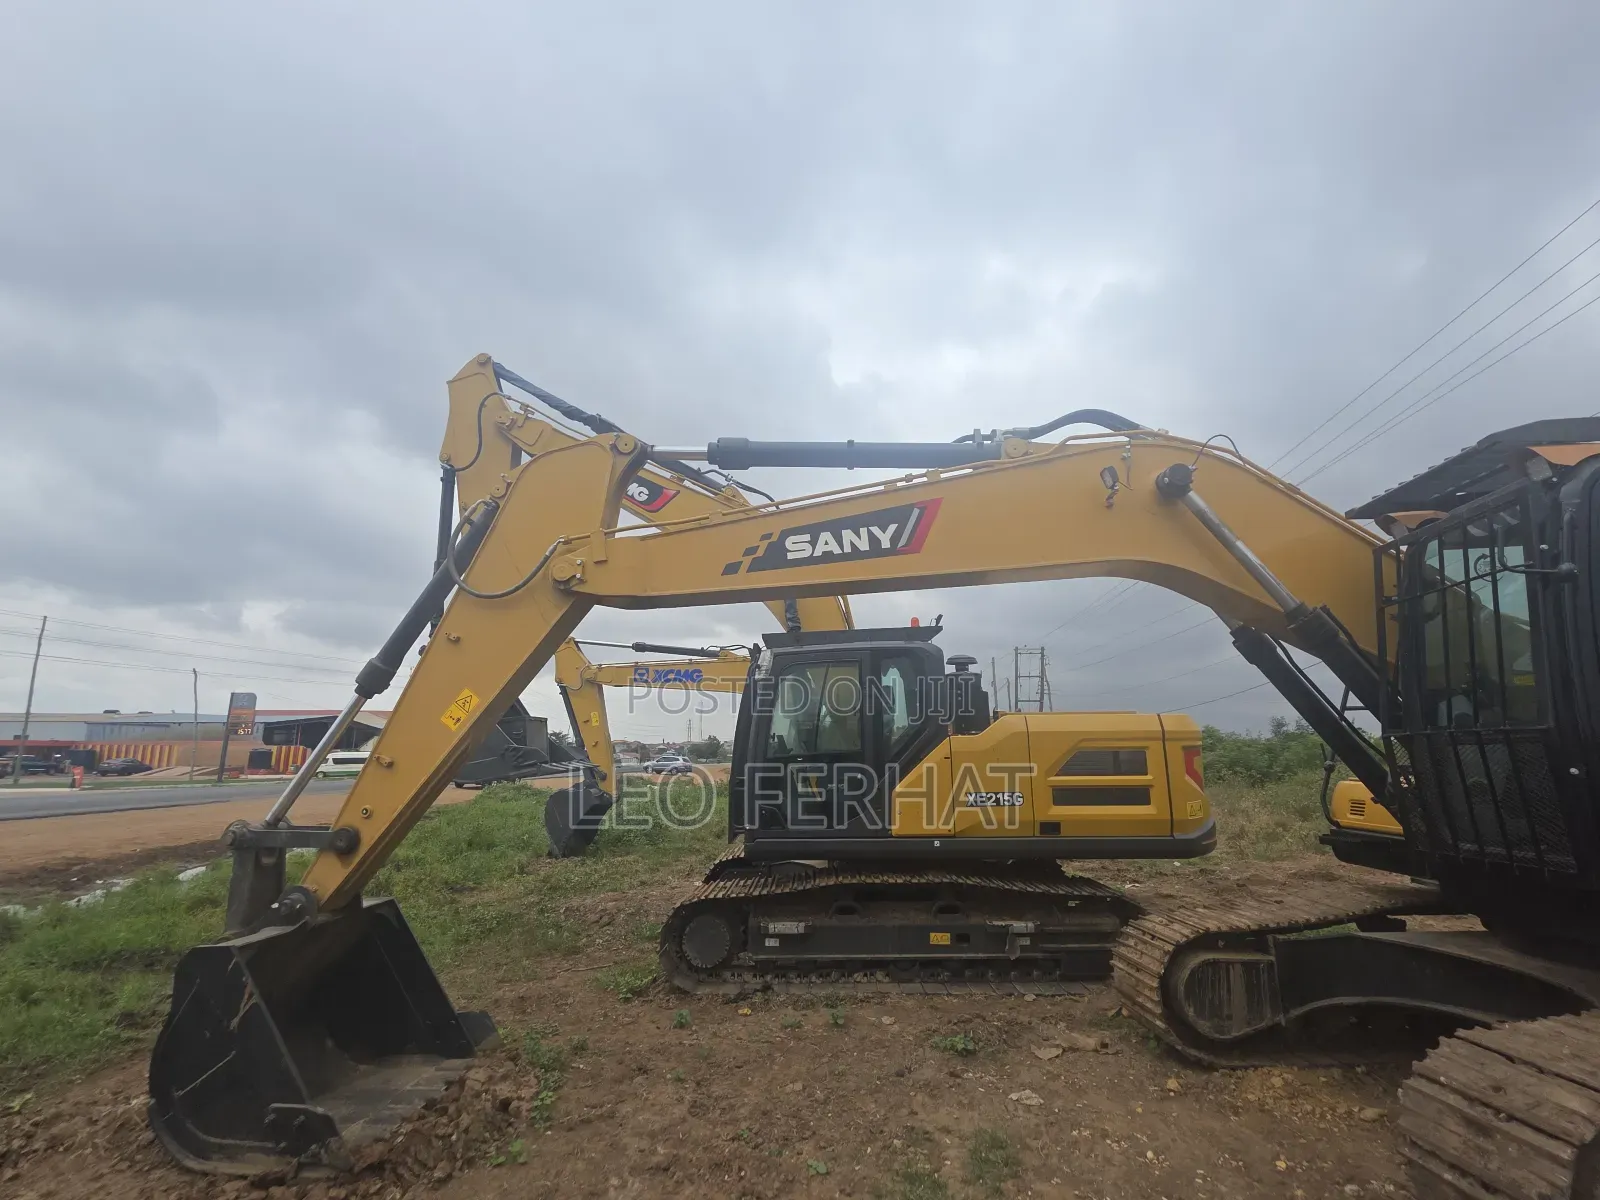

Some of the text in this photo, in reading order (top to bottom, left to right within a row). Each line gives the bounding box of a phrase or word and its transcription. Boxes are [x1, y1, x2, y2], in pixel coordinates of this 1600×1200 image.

[785, 523, 899, 560] SANY
[652, 668, 703, 683] XCMG
[966, 792, 1024, 807] XE215G
